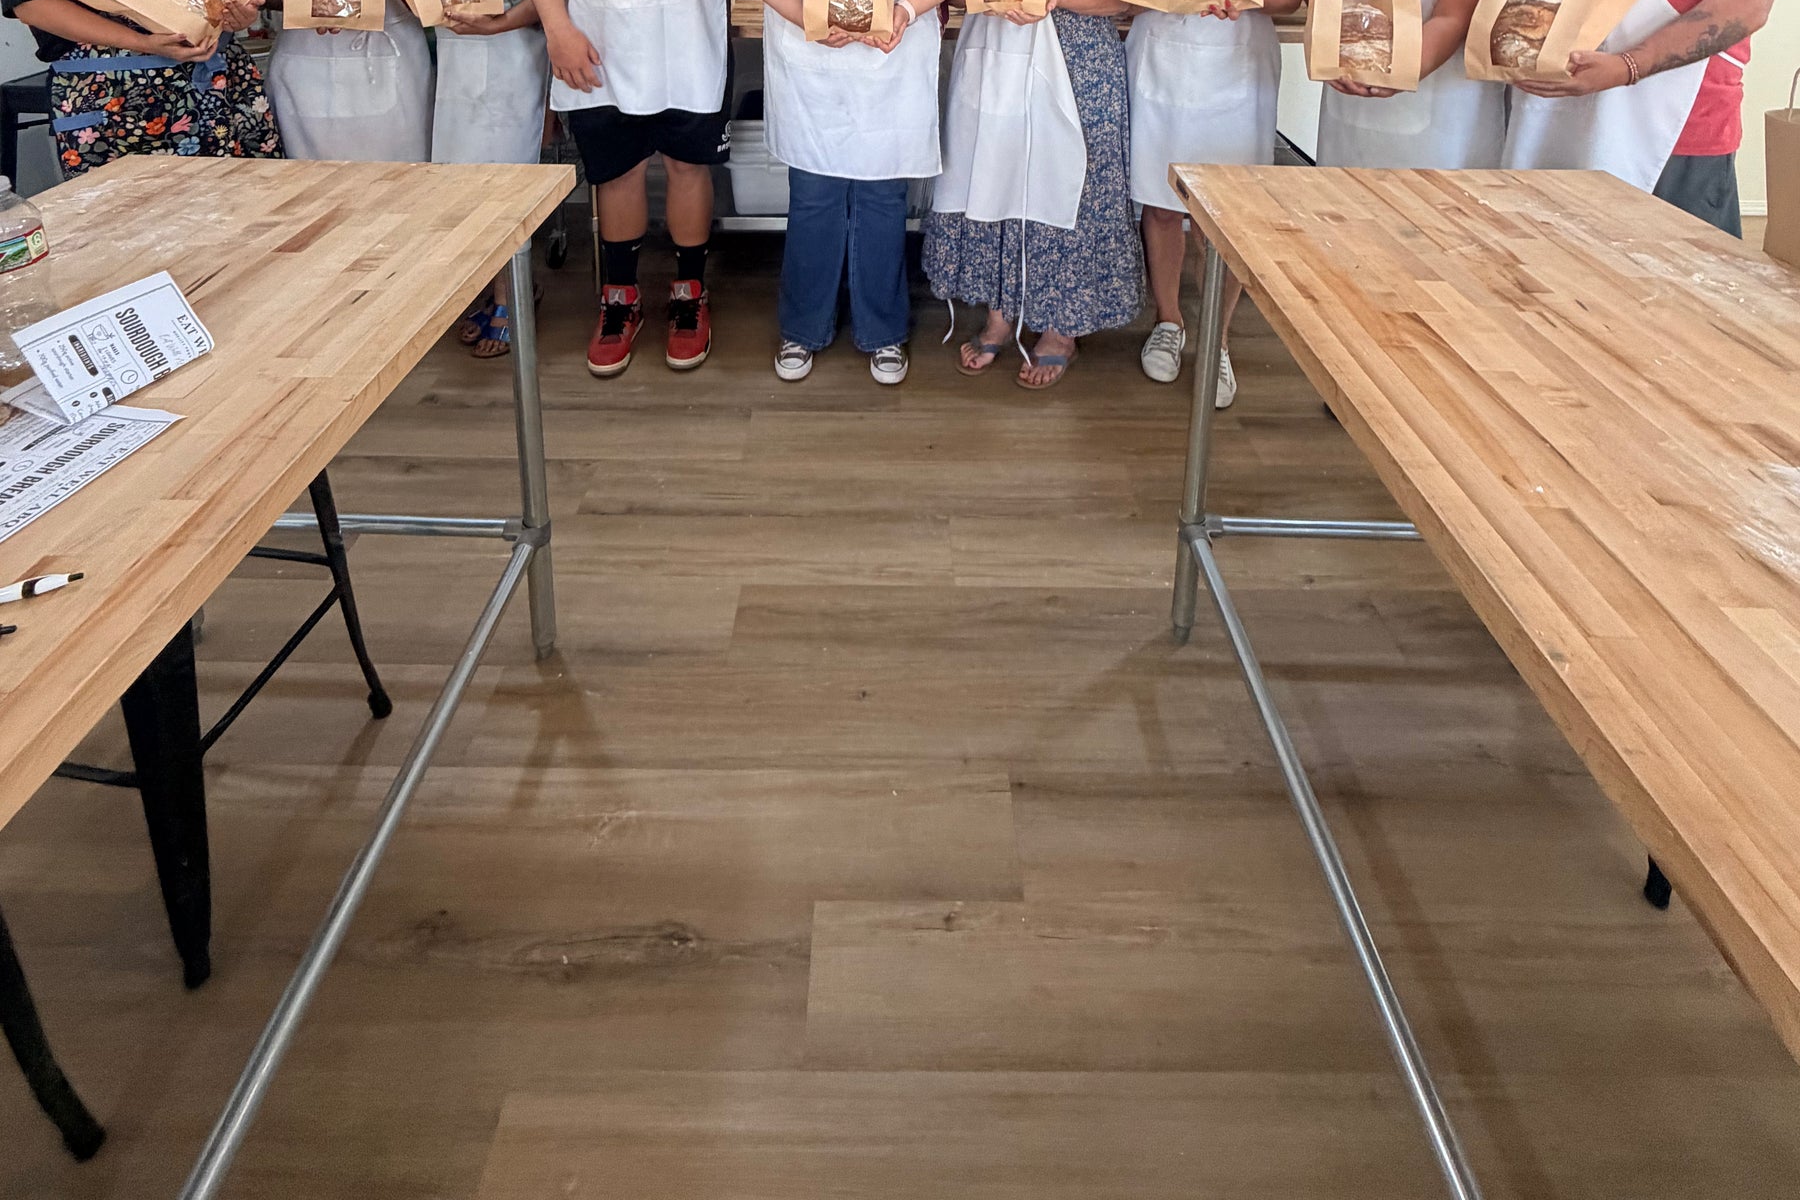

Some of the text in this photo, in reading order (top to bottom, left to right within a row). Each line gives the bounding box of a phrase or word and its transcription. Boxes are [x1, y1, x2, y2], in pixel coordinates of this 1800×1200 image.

[115, 308, 168, 371] SOURDOUGH
[175, 313, 198, 334] EAT
[34, 422, 126, 475] SOURDOUGH
[1, 447, 129, 527] EAT WELL ABQ
